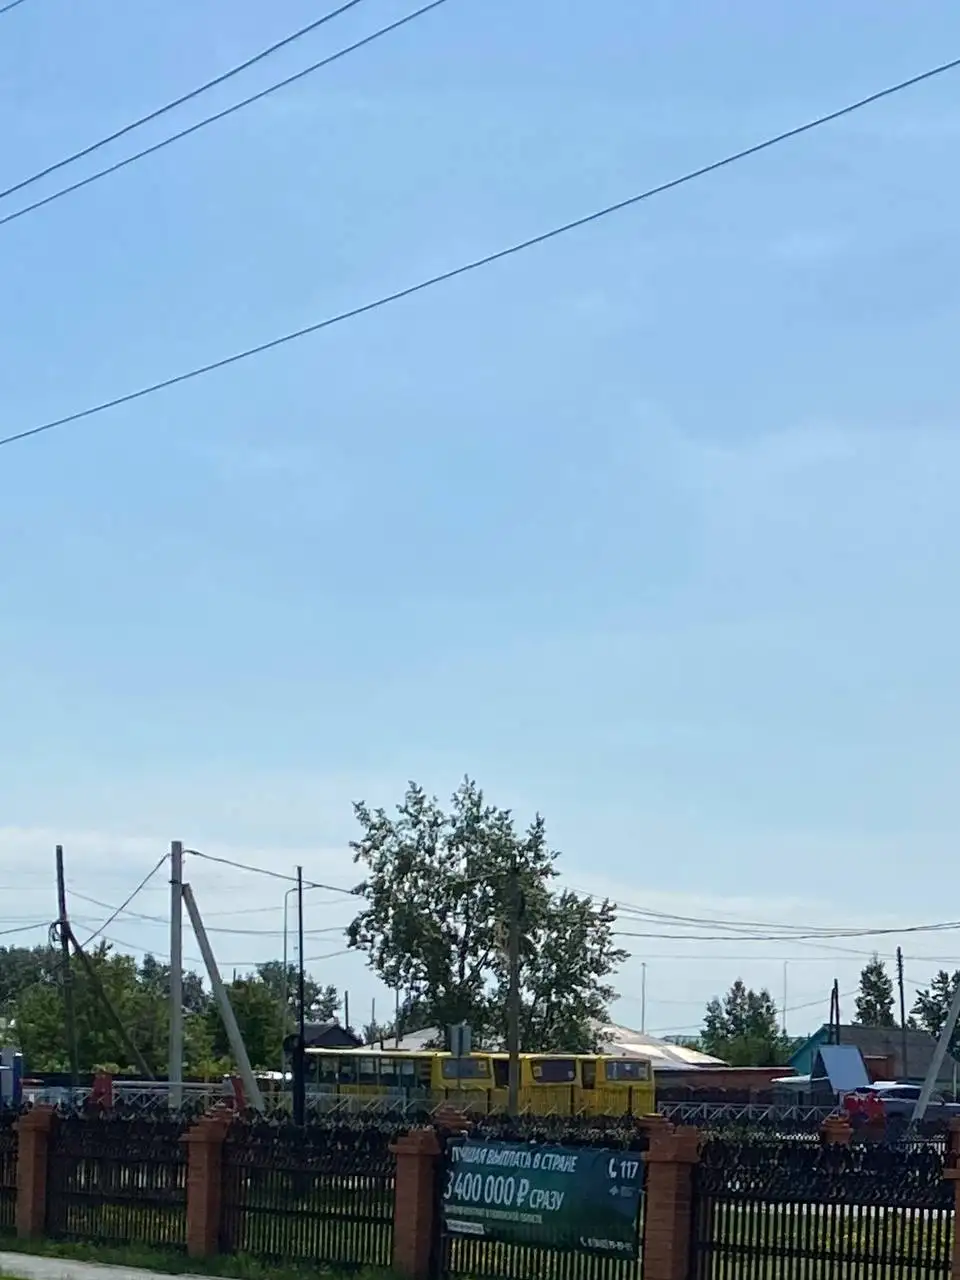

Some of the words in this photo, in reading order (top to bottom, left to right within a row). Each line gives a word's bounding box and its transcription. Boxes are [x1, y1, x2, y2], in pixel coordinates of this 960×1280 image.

[532, 1152, 541, 1169] В
[541, 1153, 578, 1173] СТРАНЕ
[620, 1160, 639, 1180] 117
[454, 1172, 482, 1202] 400
[486, 1174, 514, 1206] 000
[529, 1188, 565, 1211] СРАЗУ
